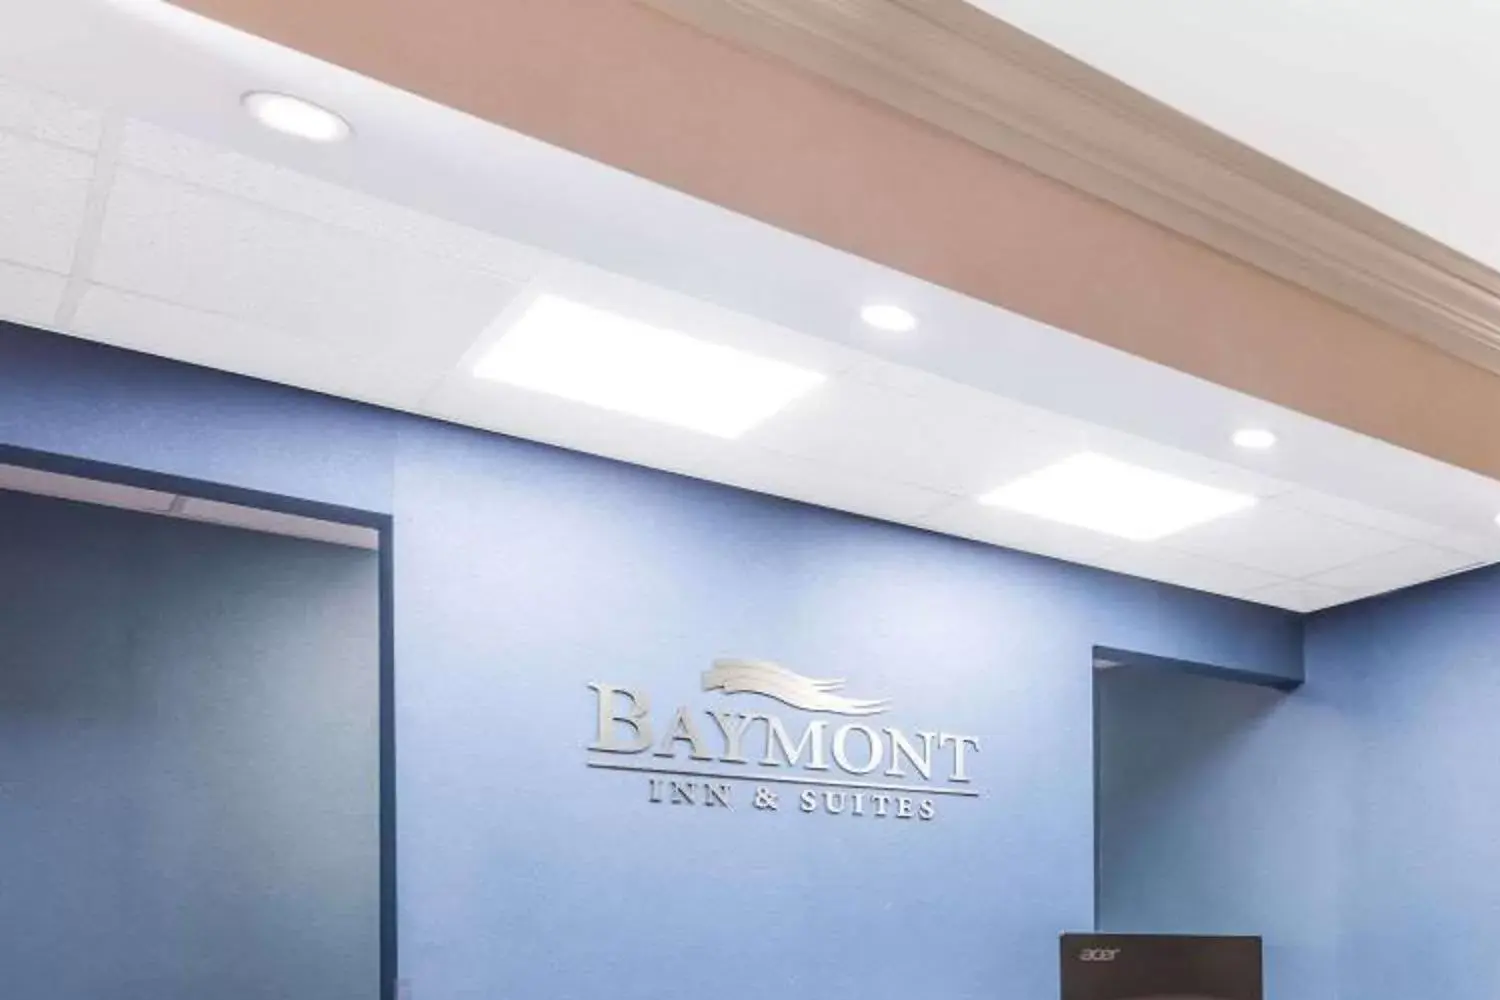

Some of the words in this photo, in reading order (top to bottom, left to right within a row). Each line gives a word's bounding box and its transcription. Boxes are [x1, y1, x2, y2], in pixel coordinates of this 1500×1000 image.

[587, 681, 980, 782] BAYMONT
[648, 778, 734, 812] INN
[753, 786, 779, 811] &
[800, 788, 936, 821] SUITES
[1080, 948, 1121, 961] acer
